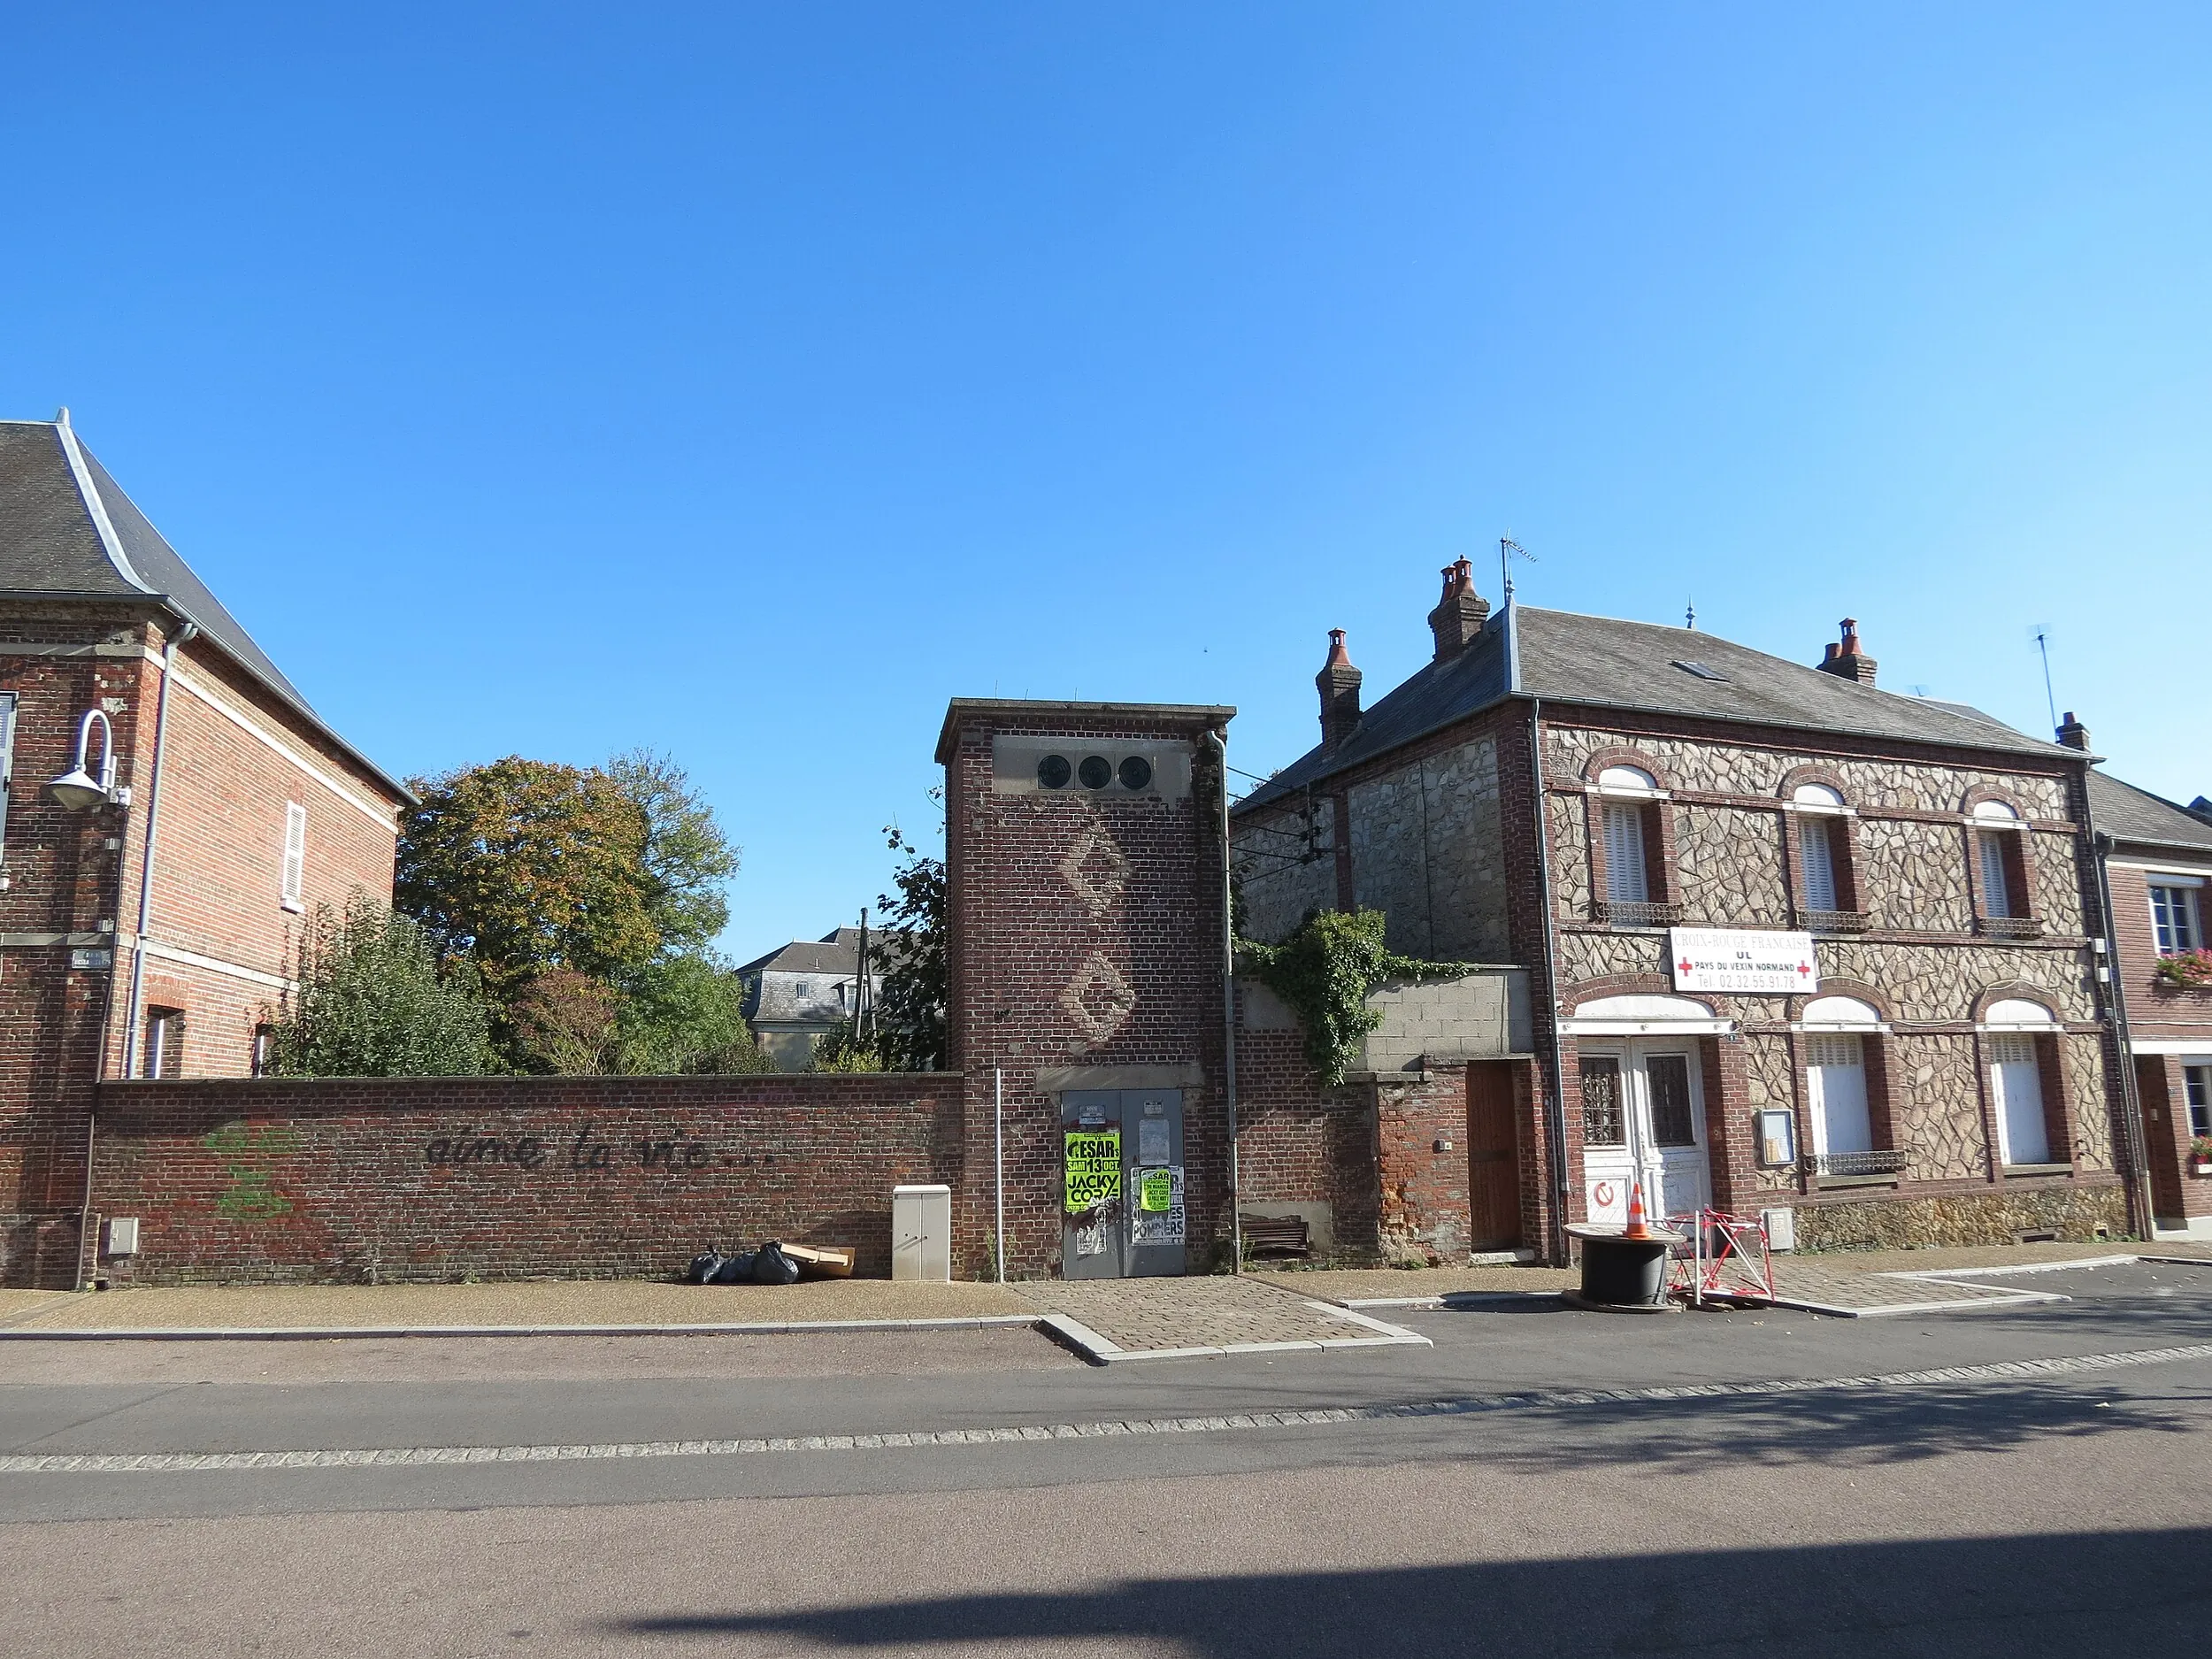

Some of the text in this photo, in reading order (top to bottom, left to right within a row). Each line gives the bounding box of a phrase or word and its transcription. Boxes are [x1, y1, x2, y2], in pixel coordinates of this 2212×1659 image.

[1674, 933, 1747, 949] CROIX-ROUGE
[1736, 951, 1753, 960] UL
[1694, 961, 1795, 972] PAYS DU VEXIN NORMAND
[1719, 974, 1795, 988] 02.32.55.91.78
[573, 1123, 615, 1169] la
[1067, 1161, 1086, 1171] SAM
[1087, 1158, 1102, 1173] 13
[1067, 1174, 1119, 1199] JACKY
[1133, 1220, 1184, 1239] POERS
